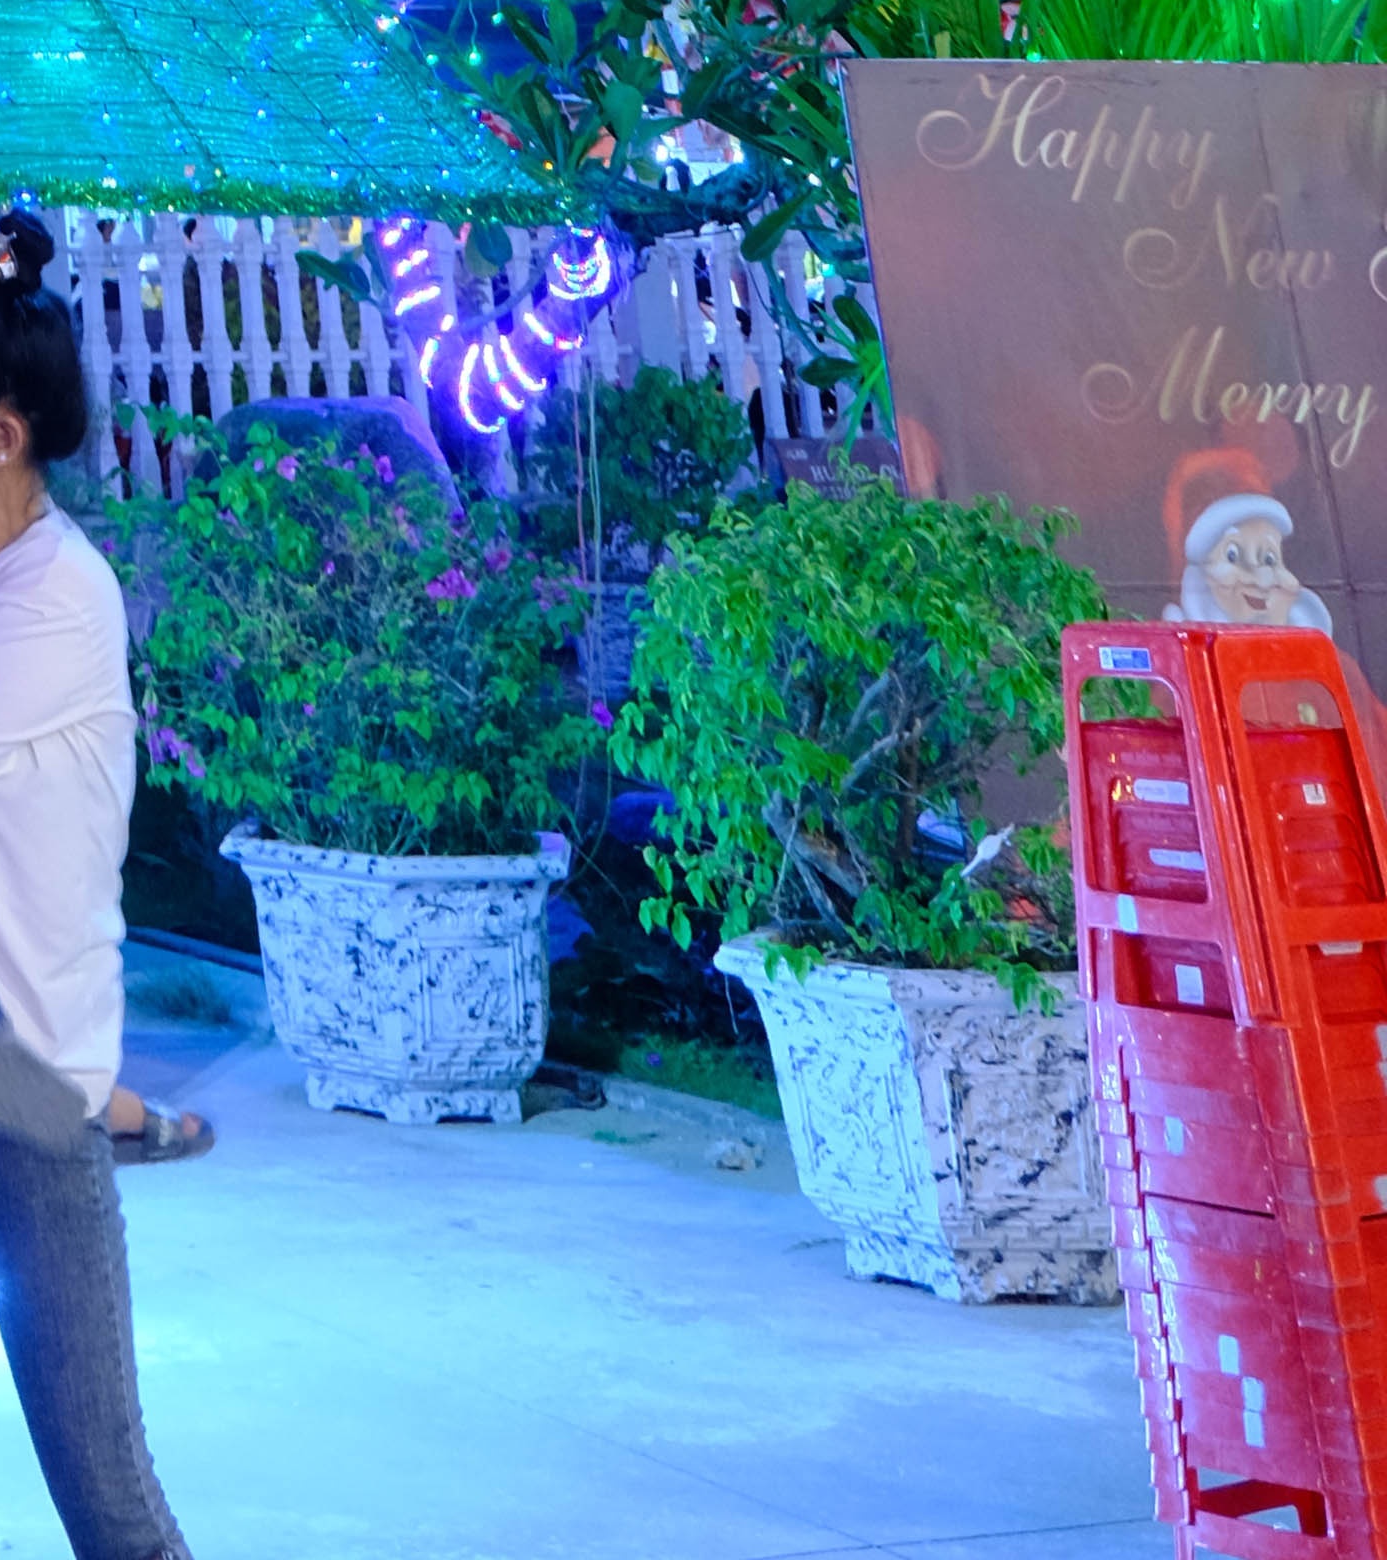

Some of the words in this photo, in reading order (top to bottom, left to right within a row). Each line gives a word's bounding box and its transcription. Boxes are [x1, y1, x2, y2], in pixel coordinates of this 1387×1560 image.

[915, 74, 1215, 211] Happy
[1123, 192, 1335, 290] New
[1079, 324, 1378, 469] Merry
